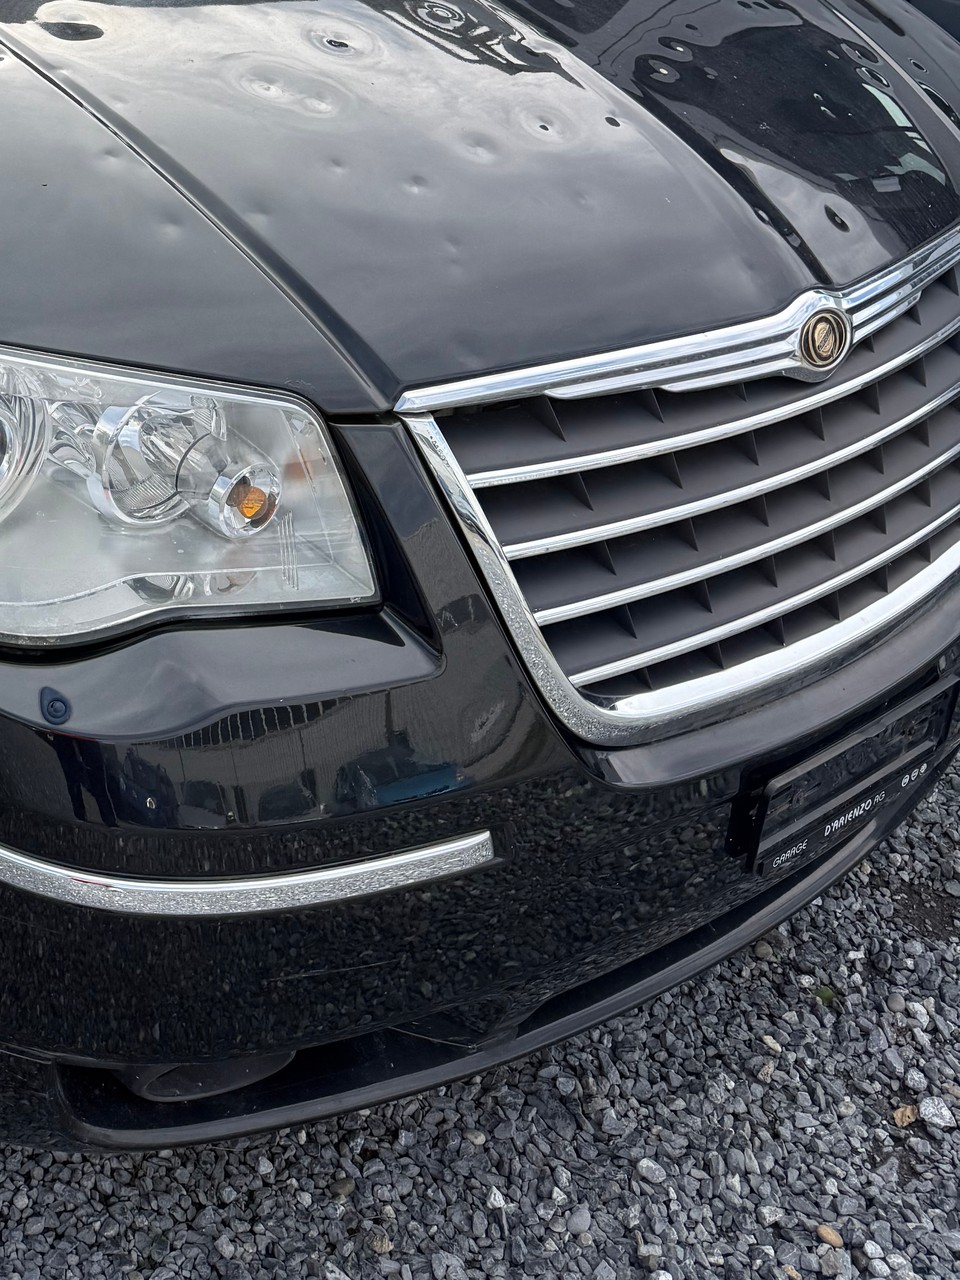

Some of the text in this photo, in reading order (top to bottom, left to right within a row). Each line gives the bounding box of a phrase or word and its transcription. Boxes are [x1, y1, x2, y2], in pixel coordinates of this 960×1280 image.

[772, 790, 886, 868] GARAGE D'ARIENZO AG
